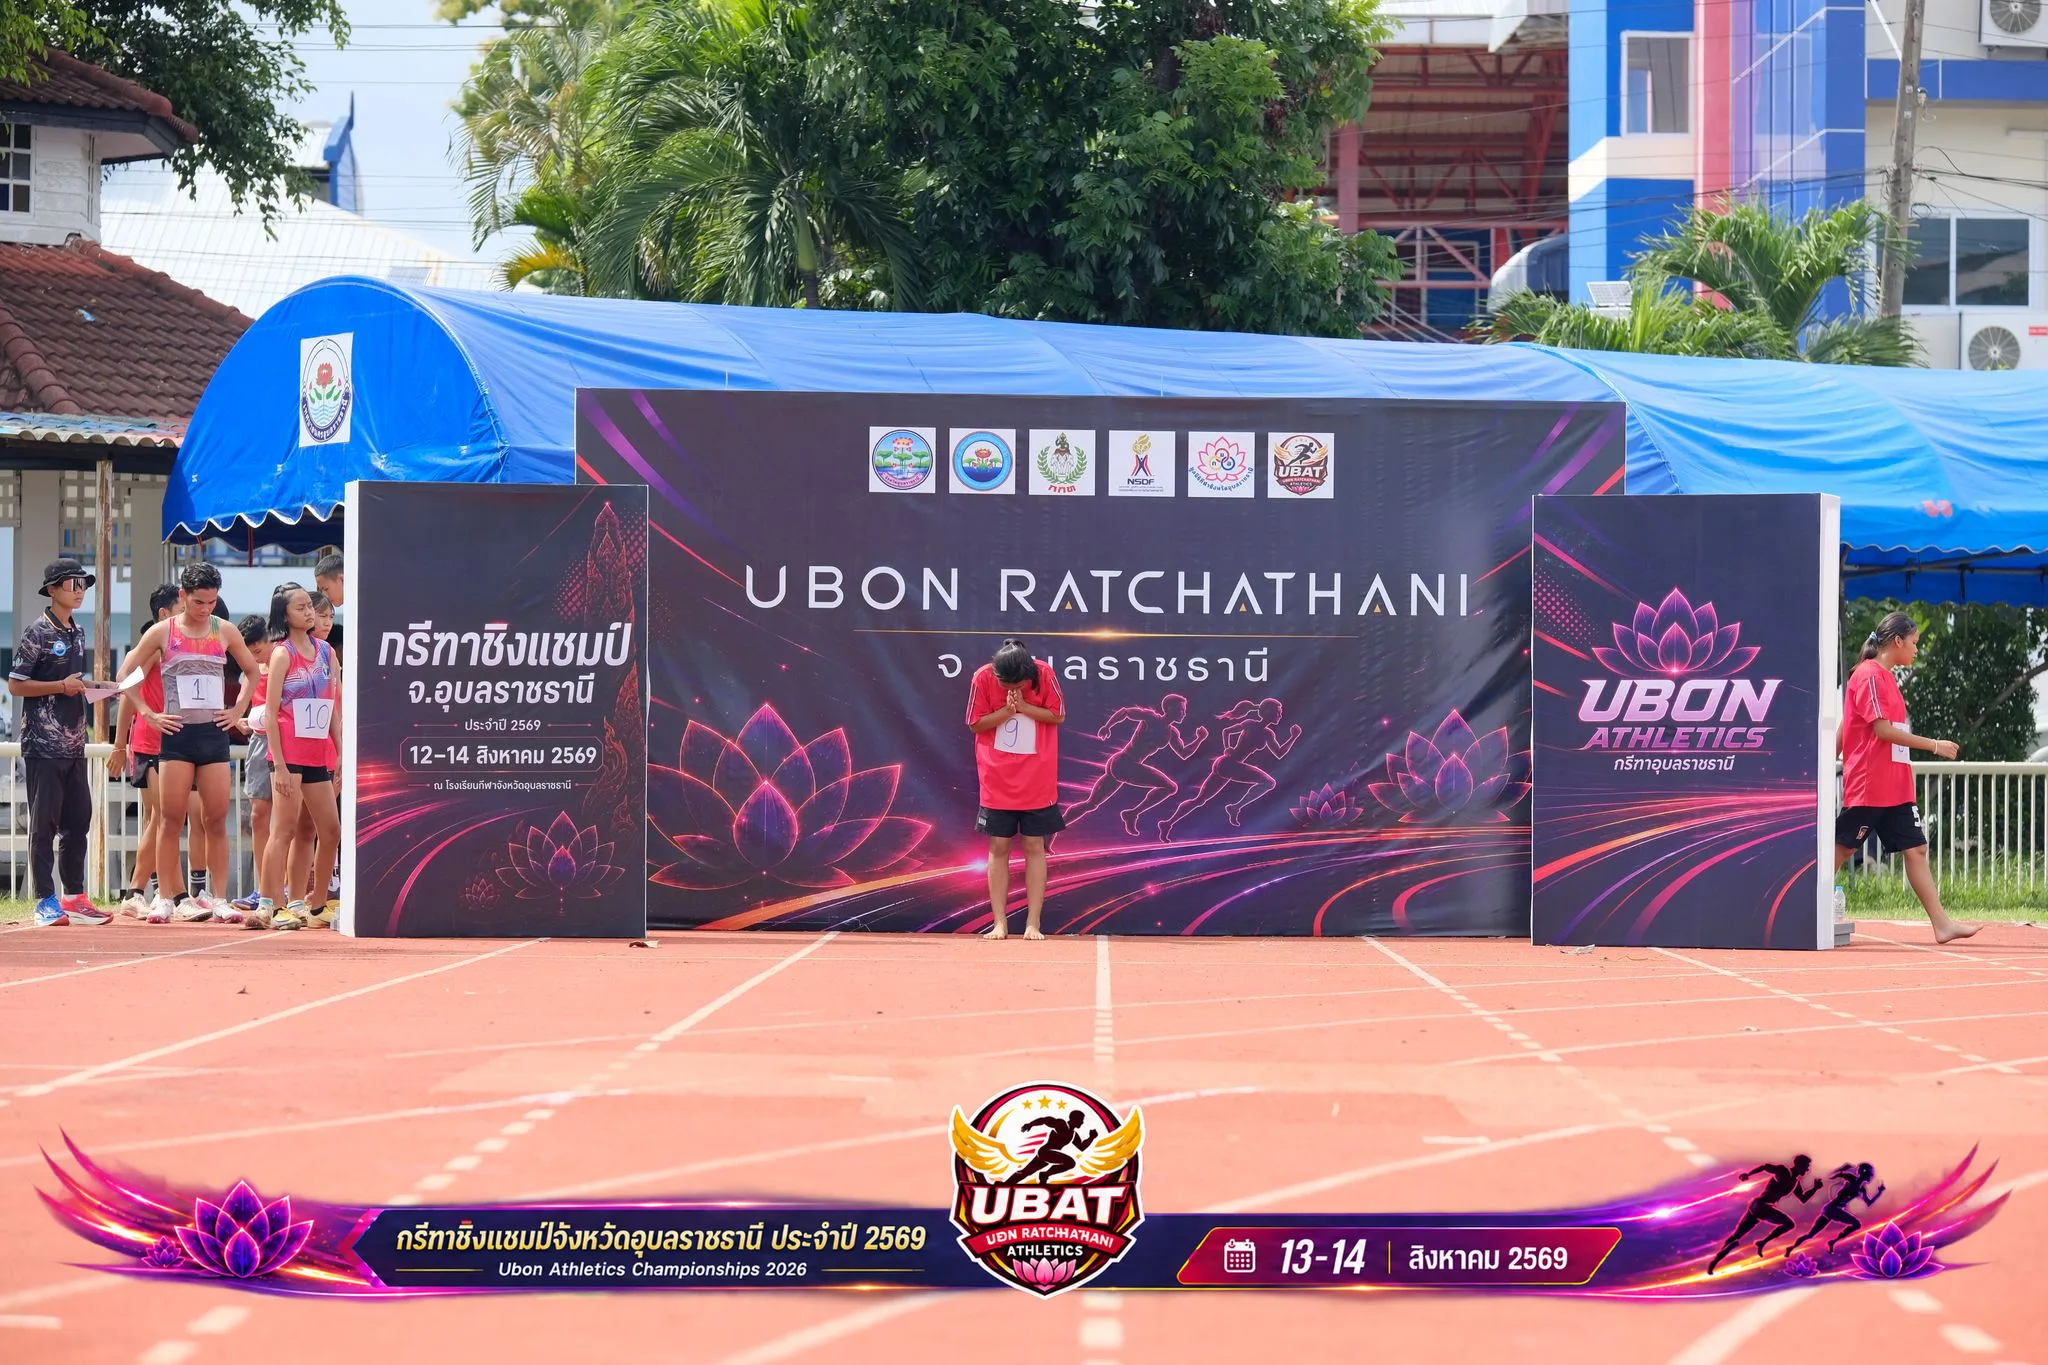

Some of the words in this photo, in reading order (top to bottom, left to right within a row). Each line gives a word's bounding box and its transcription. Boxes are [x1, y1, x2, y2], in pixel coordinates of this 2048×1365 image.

[1278, 466, 1323, 478] UBAT
[746, 564, 958, 611] UBON
[1000, 568, 1468, 617] RATCHATHANI
[378, 620, 632, 667] กรีฑาชิงแชมป์
[191, 678, 205, 701] 1
[409, 672, 595, 713] จ.อุบลราชธานี
[1578, 679, 1784, 722] UBON
[304, 703, 329, 730] 10
[464, 718, 507, 731] ประจำปี
[511, 719, 541, 731] 2569
[1003, 717, 1019, 748] 9
[1578, 727, 1777, 750] ATHLETICS
[476, 745, 545, 765] สิงหาคม
[551, 746, 597, 765] 2569
[1613, 755, 1736, 775] กรีฑาอุบลราชธานี
[433, 782, 443, 790] ณ
[445, 779, 572, 793] โรงเรียนกีฬาจังหวัดอุบลราชธานี
